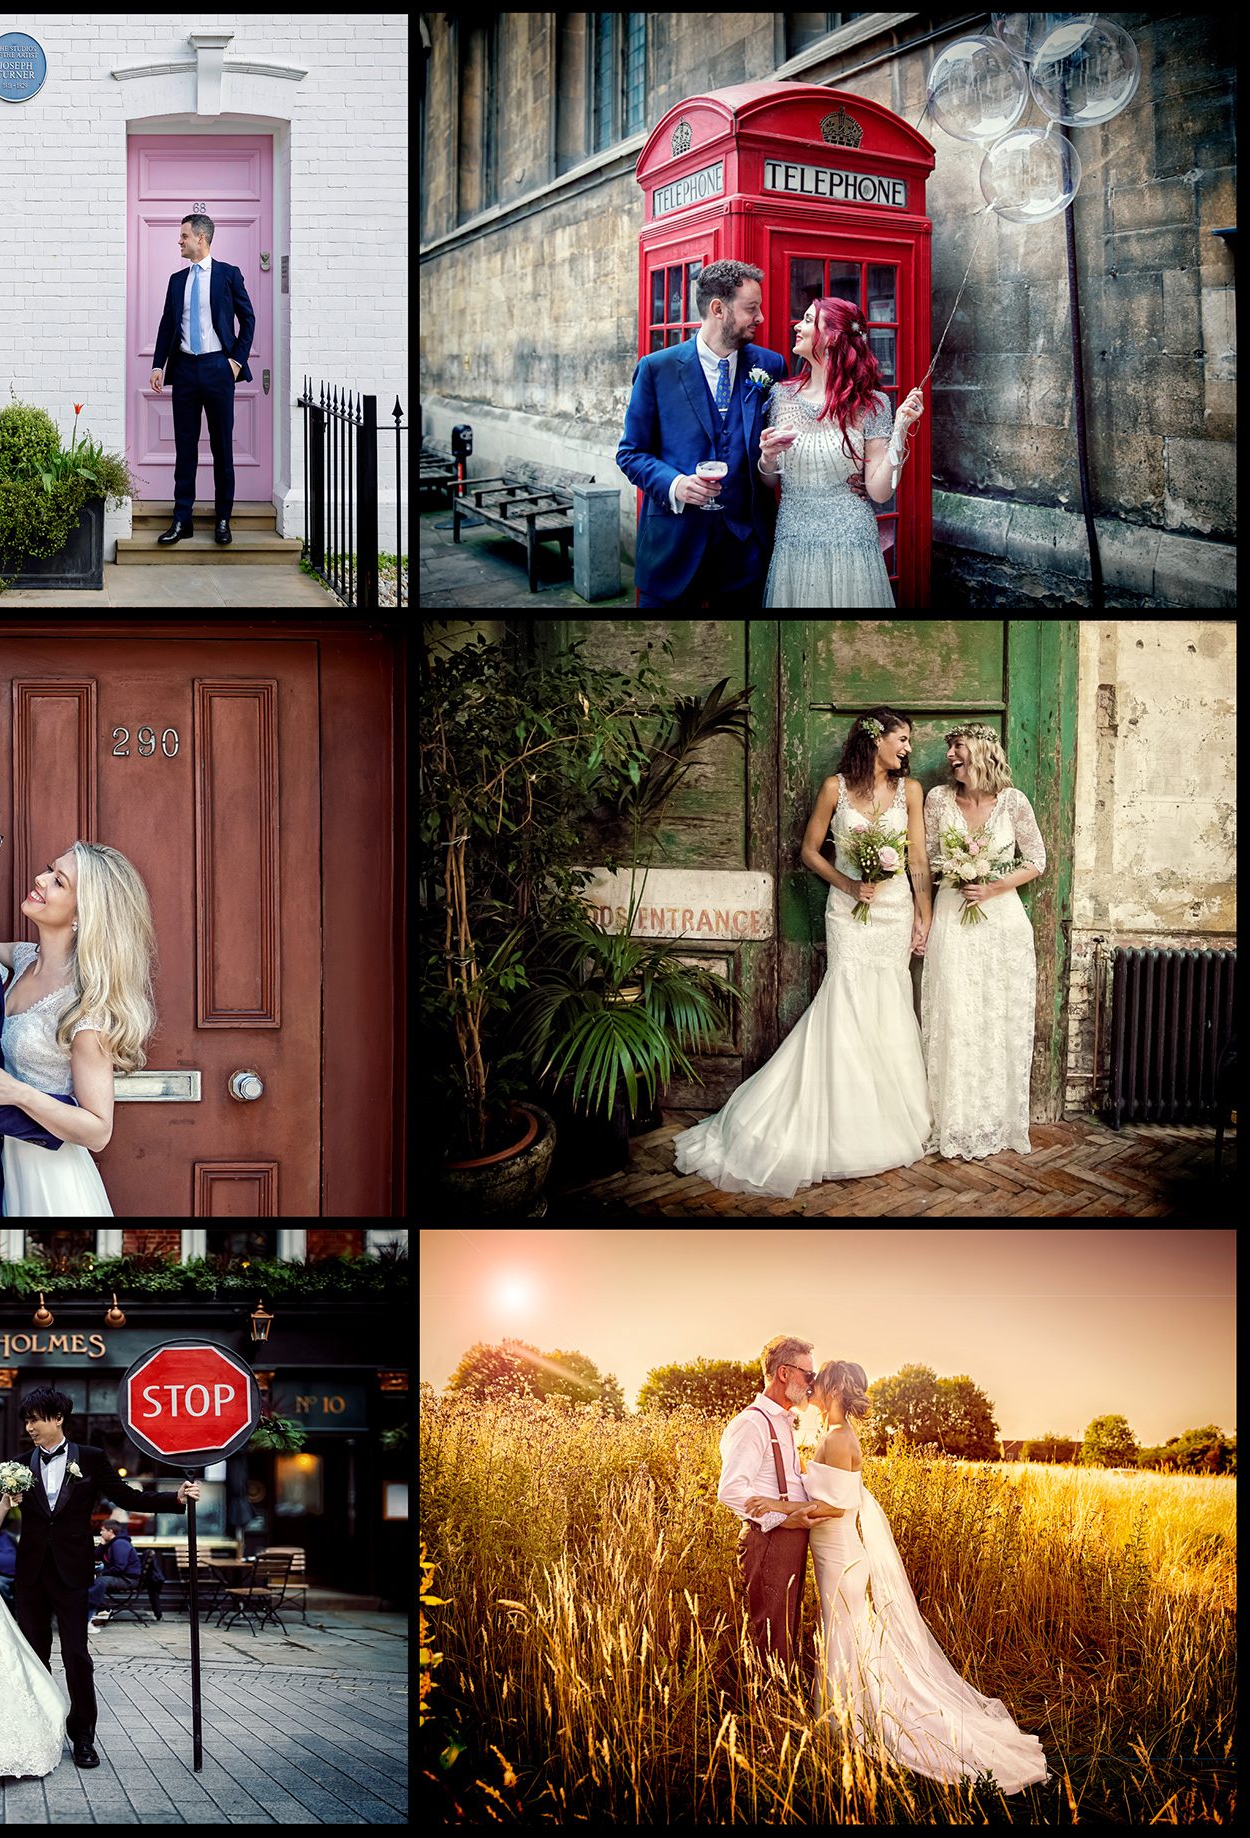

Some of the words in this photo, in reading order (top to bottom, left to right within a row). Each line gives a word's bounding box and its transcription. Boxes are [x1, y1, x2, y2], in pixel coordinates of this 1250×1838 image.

[656, 165, 723, 213] TELEPHONE
[765, 162, 905, 206] TELEPHONE
[193, 202, 207, 213] 68
[112, 726, 179, 757] 290
[637, 907, 761, 934] ENTRANCE
[142, 1384, 235, 1419] STOP
[323, 1395, 346, 1414] 10
